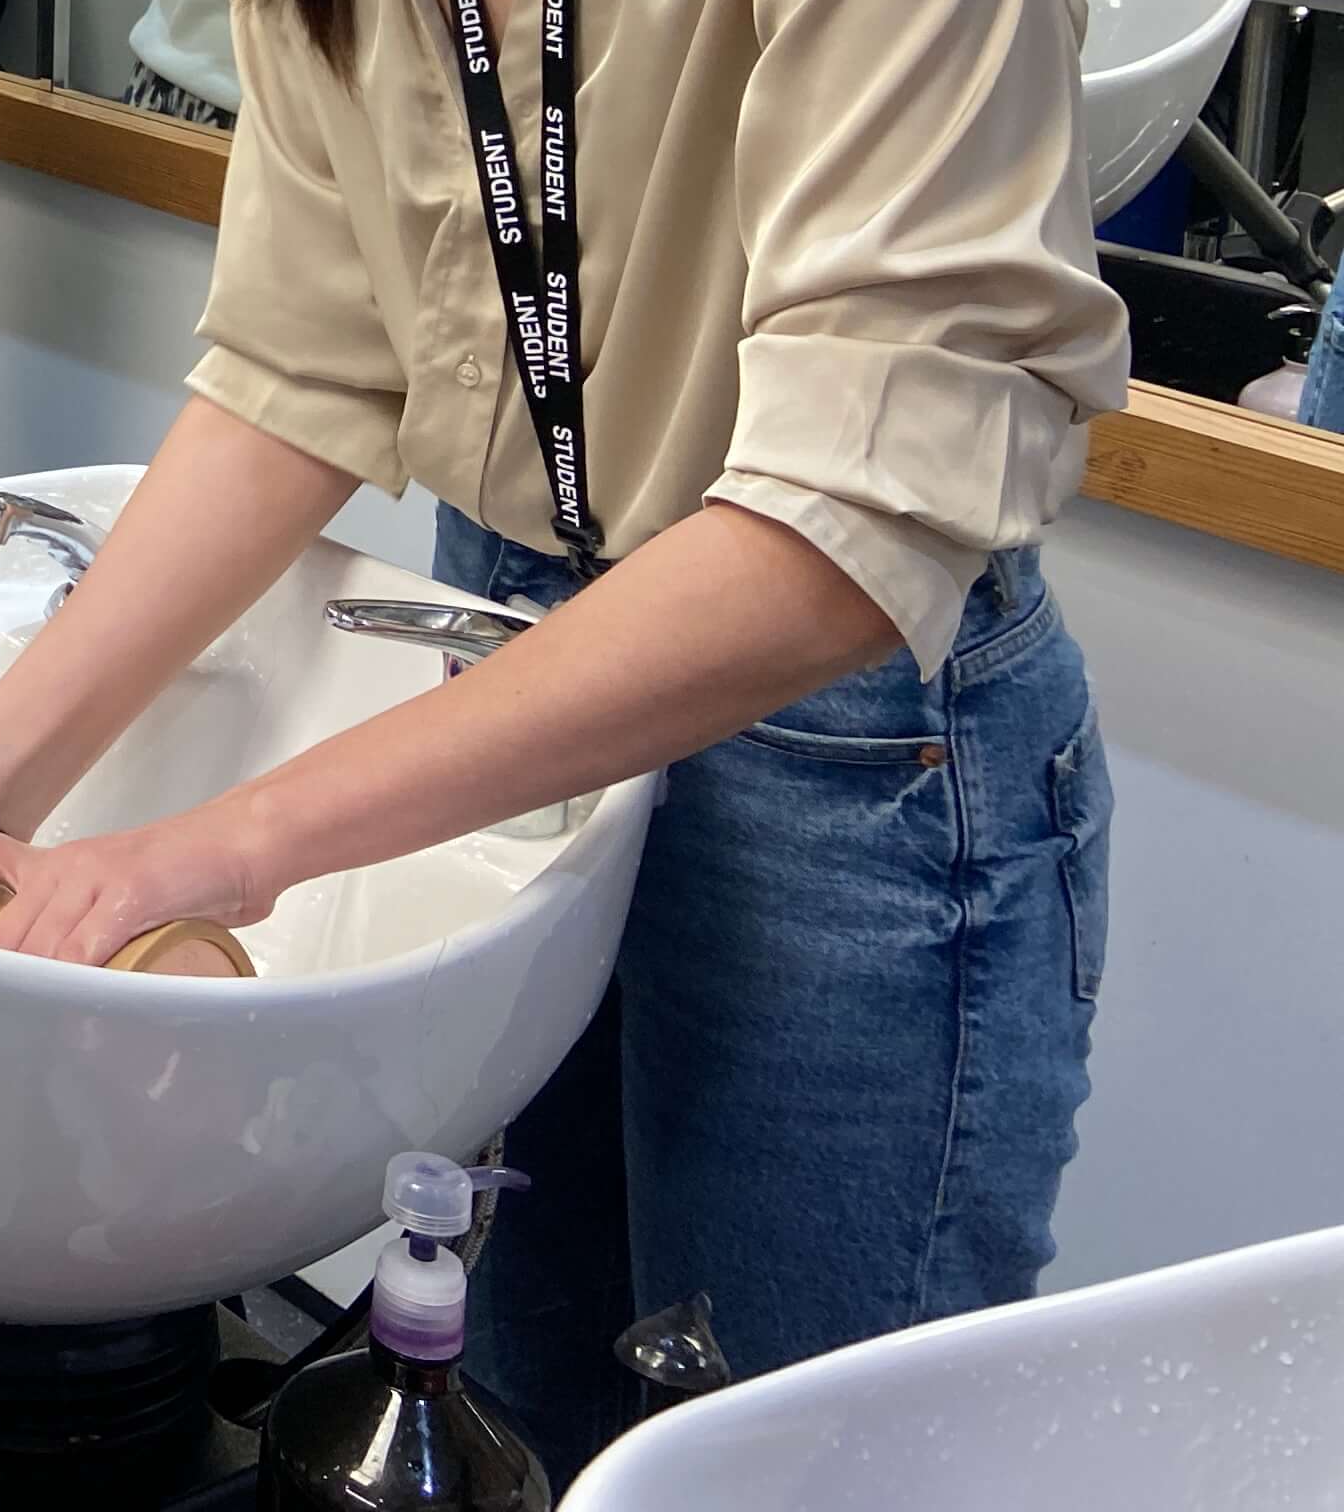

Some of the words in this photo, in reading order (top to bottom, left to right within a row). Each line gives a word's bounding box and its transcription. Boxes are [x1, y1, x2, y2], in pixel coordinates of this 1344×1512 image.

[480, 130, 522, 245] STUDENT
[545, 104, 566, 220] STUDENT
[546, 271, 570, 382] STUDENT
[552, 424, 580, 527] STUDENT
